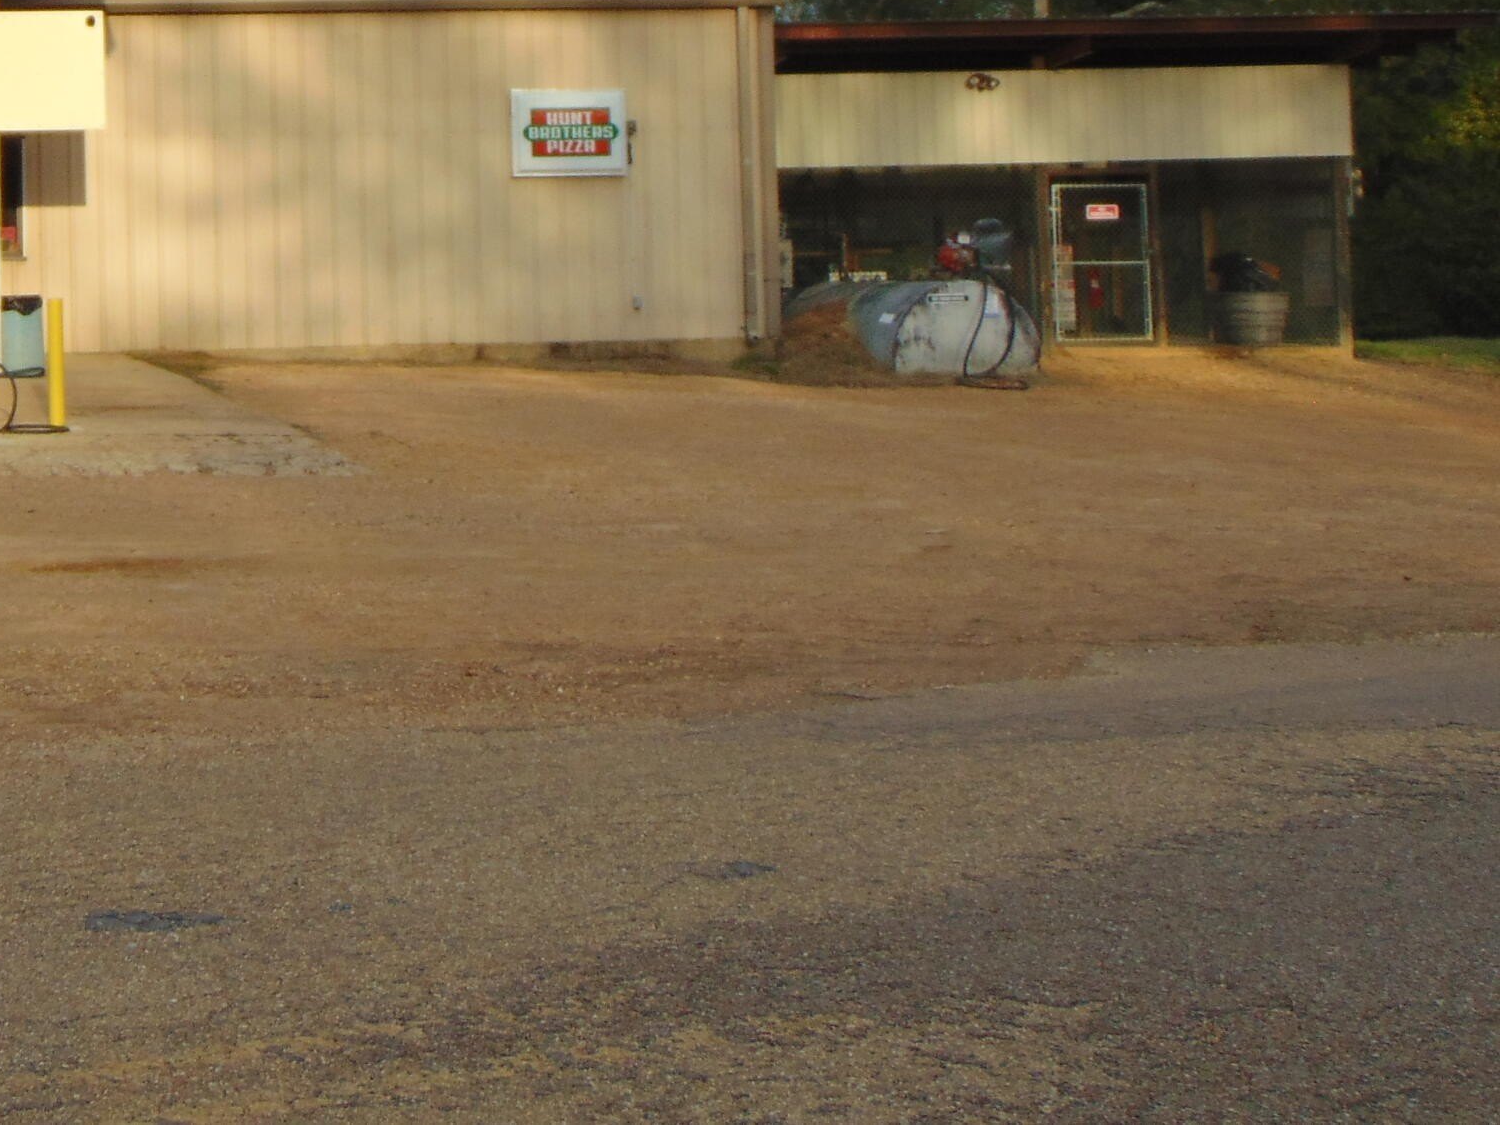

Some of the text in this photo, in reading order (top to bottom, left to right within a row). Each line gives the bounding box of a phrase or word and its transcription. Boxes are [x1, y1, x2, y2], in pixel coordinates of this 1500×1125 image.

[546, 111, 593, 125] HUNT
[528, 126, 614, 139] BROTHERS
[546, 140, 595, 153] PIZZA
